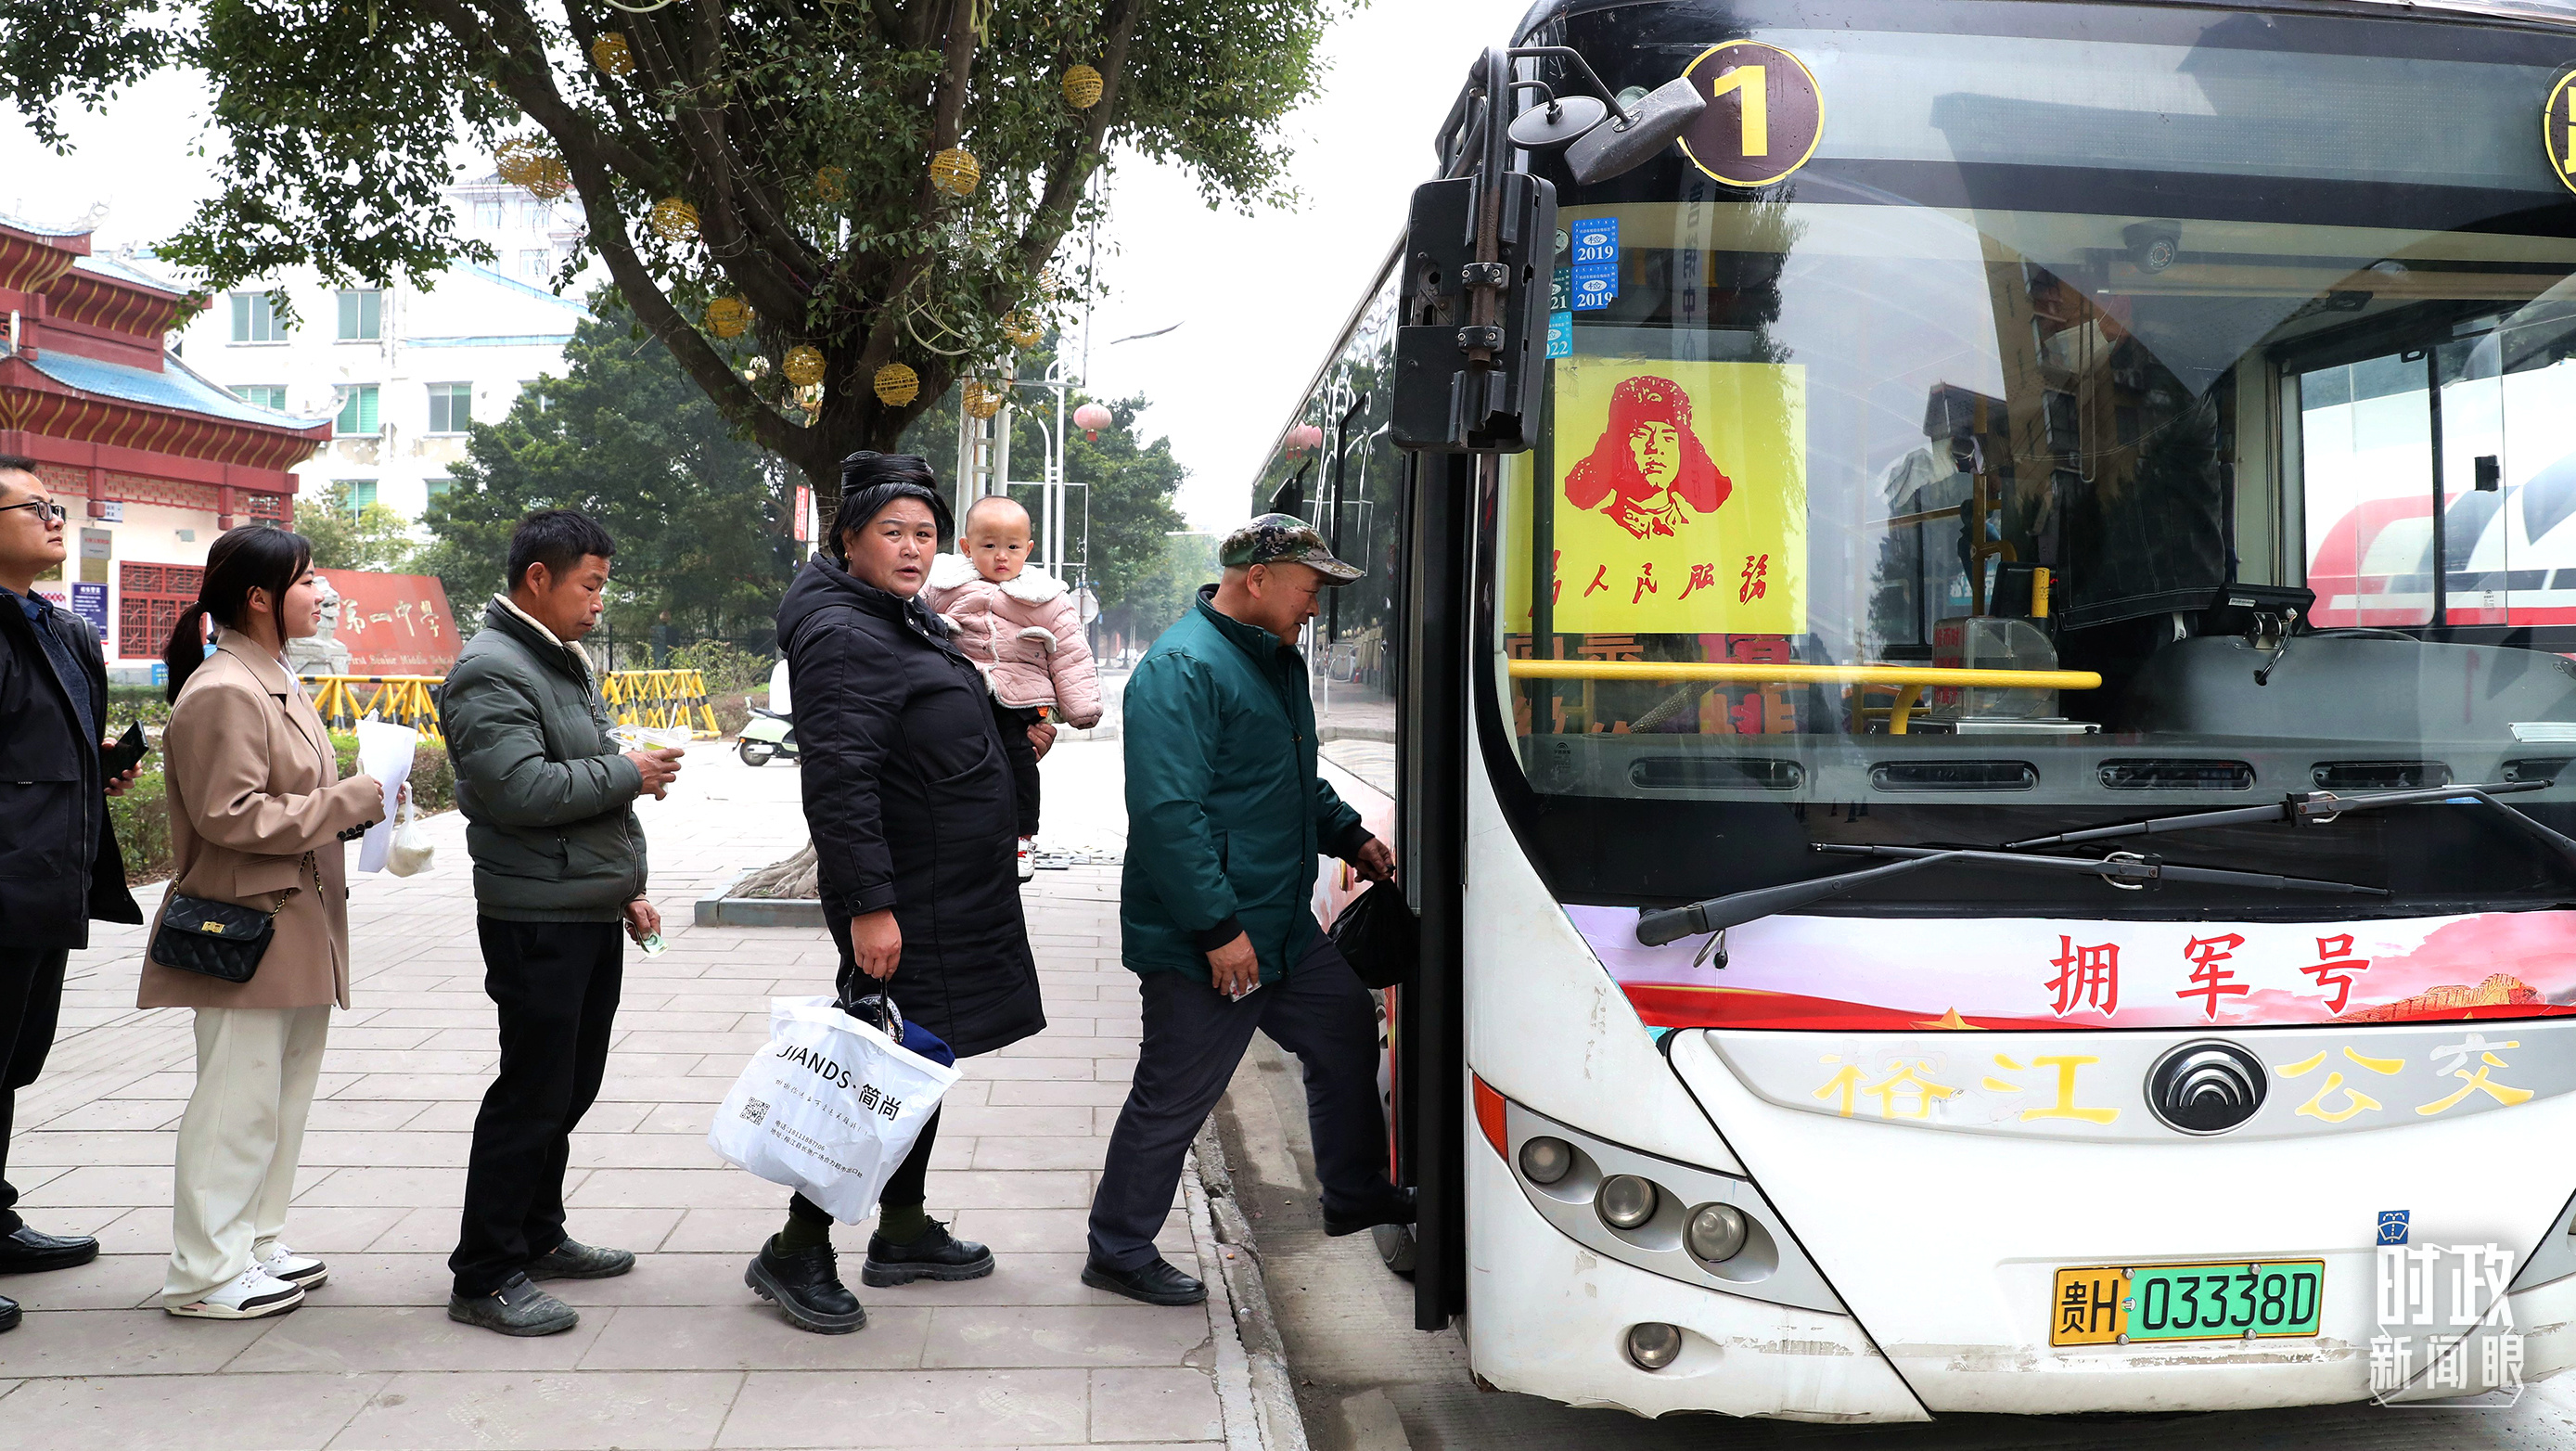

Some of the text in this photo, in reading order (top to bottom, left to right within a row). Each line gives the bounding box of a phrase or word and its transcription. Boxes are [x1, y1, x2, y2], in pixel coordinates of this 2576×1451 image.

[1714, 66, 1768, 156] 1
[1577, 245, 1614, 262] 2019
[1550, 295, 1568, 310] 21
[1577, 291, 1614, 308] 2019
[369, 654, 397, 665] Senior
[400, 654, 428, 665] Middle
[2044, 932, 2371, 1021] 拥军号
[2273, 1033, 2535, 1124] 公交
[2060, 1272, 2316, 1334] 贵H 03338D
